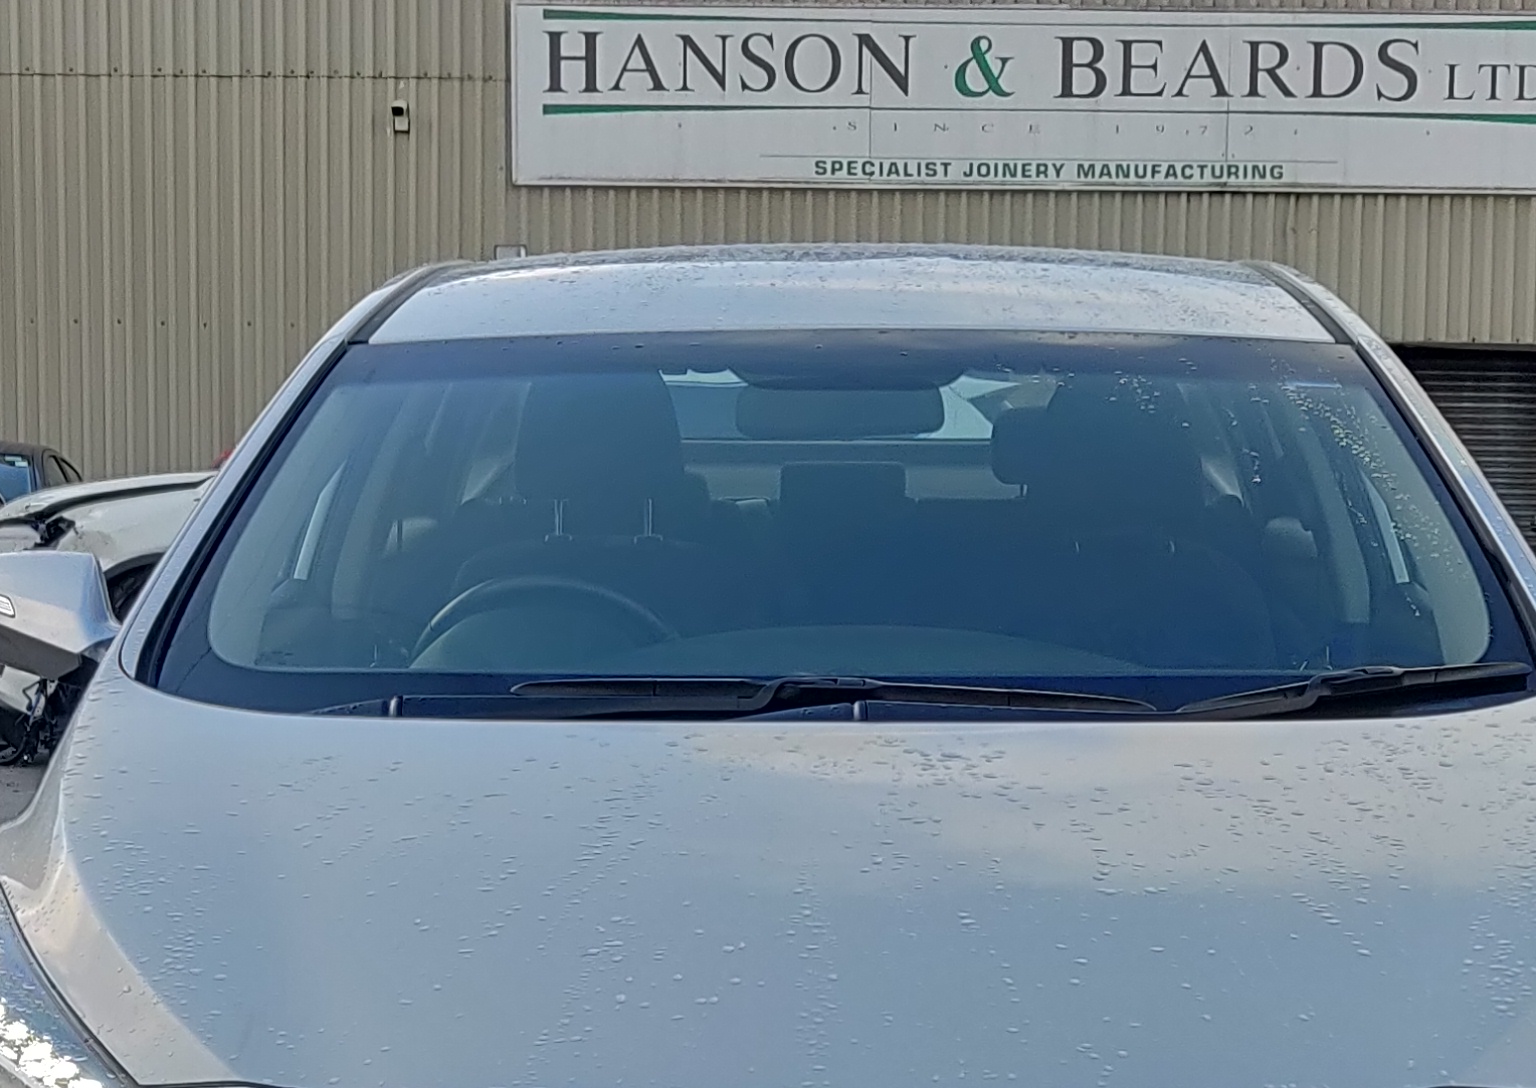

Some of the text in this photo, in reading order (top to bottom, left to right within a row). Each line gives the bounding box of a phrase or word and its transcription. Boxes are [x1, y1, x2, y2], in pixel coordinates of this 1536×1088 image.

[543, 30, 917, 97] HANSON
[953, 35, 1016, 97] &
[1053, 35, 1420, 102] BEARDS
[814, 160, 1284, 180] SPECIALIST JOINERY MANUFACTURING
